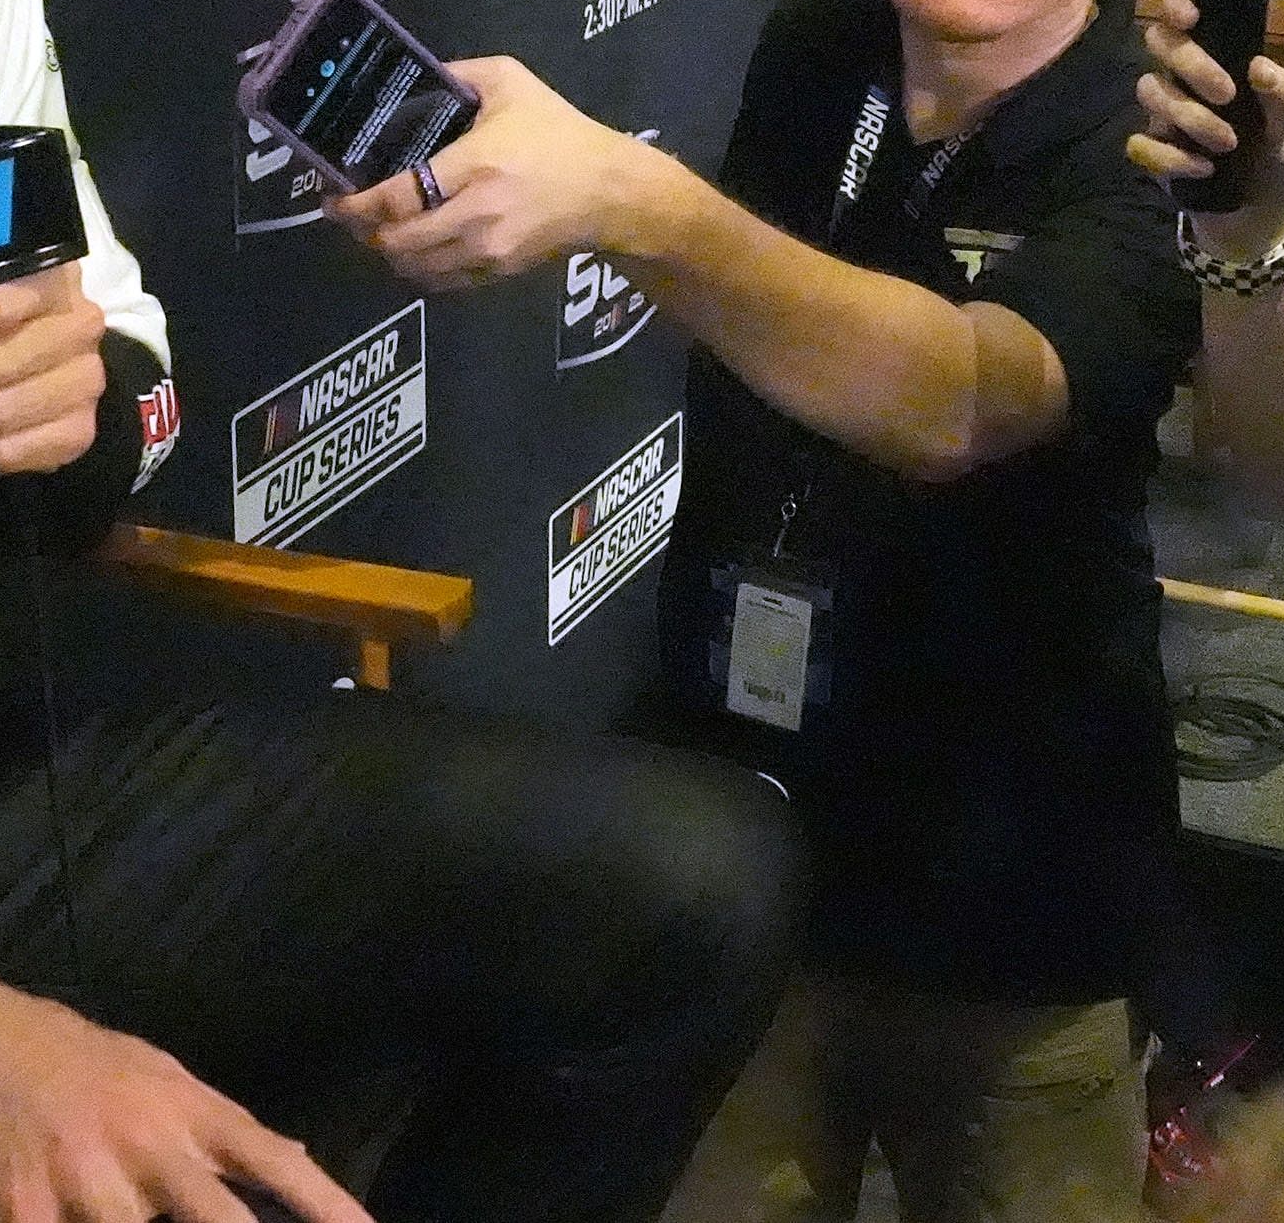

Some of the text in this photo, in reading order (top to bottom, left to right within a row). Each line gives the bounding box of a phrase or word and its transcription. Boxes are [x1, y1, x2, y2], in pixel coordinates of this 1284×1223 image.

[298, 329, 397, 432] NASCAR
[263, 456, 315, 521] CUP
[318, 393, 403, 479] SERIES
[593, 435, 664, 534] NASCAR
[568, 495, 665, 601] CUP SERIES
